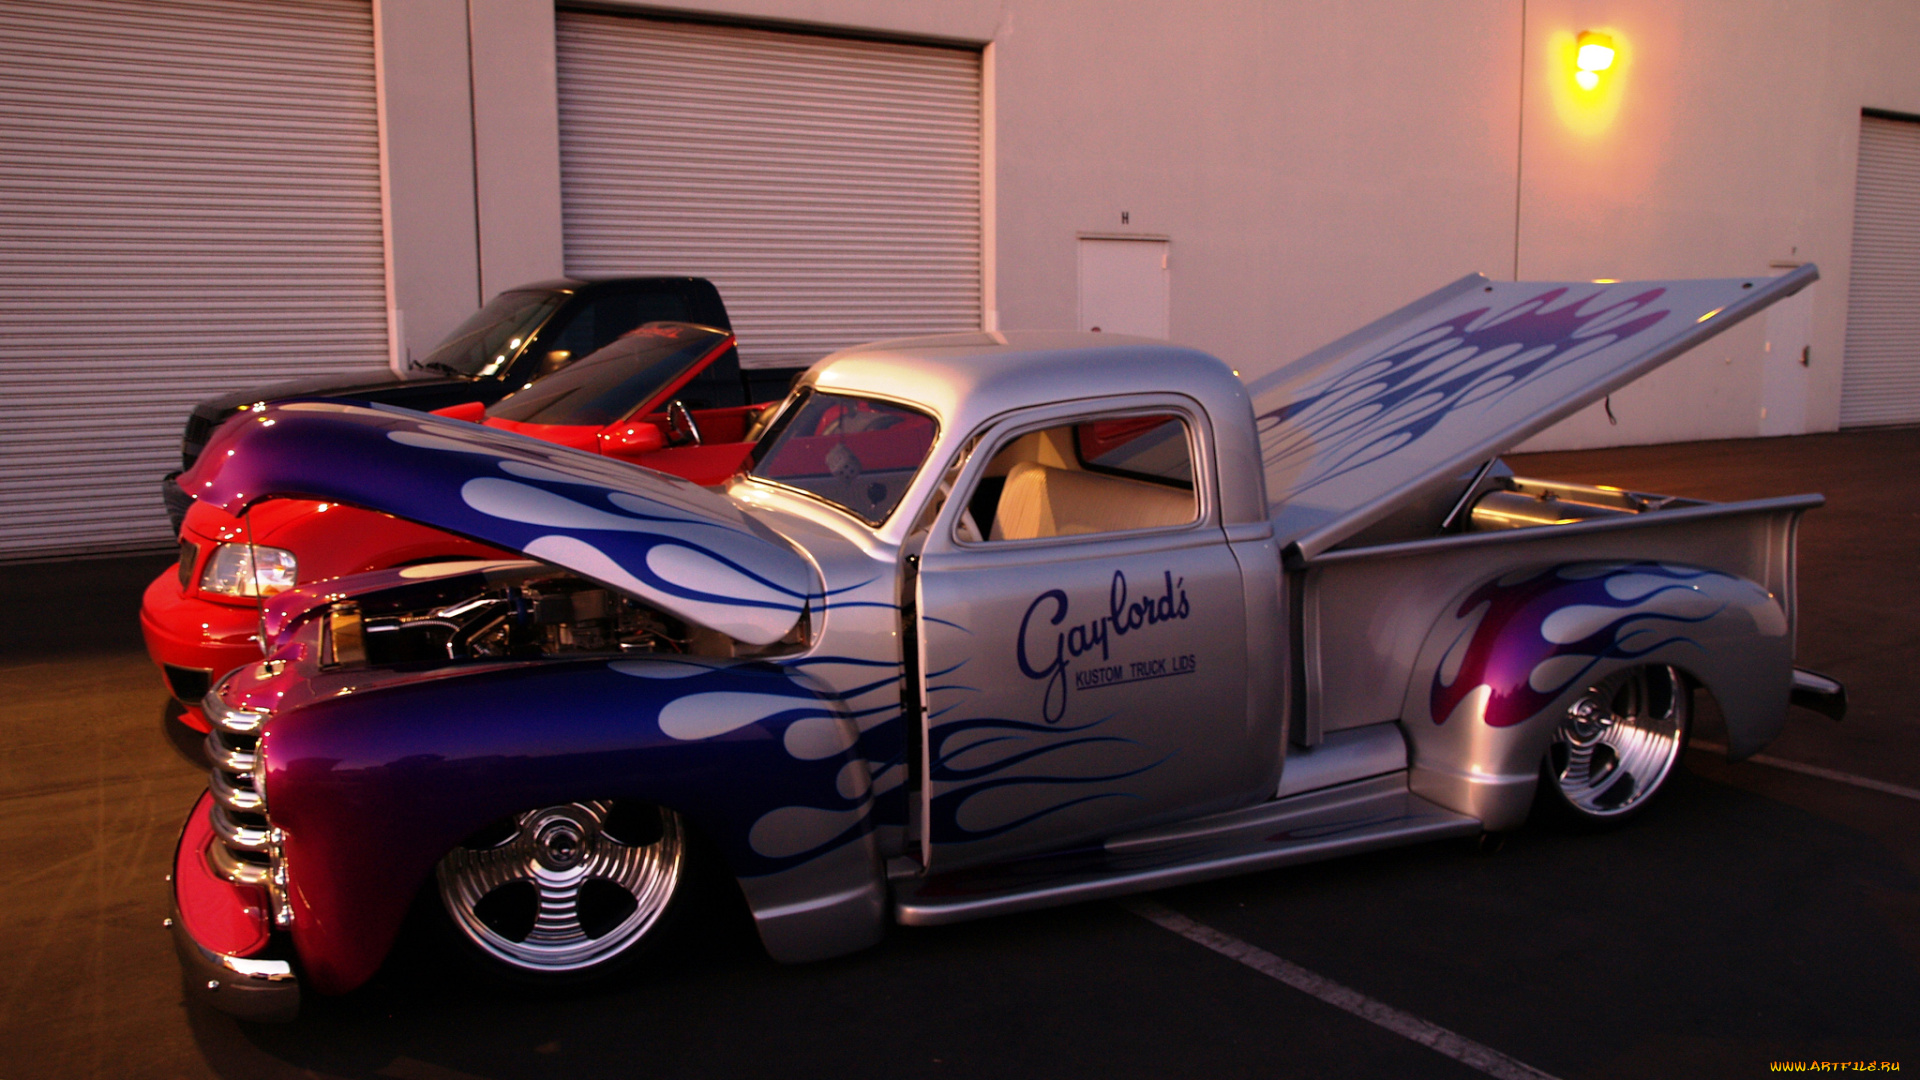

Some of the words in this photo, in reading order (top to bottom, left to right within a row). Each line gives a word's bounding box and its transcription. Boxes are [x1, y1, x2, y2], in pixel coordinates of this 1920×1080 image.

[1121, 211, 1129, 225] H
[1017, 569, 1190, 724] Gaylord's
[1075, 665, 1123, 687] KUSTOM
[1130, 659, 1167, 677] TRUCK
[1172, 654, 1196, 671] LIDS
